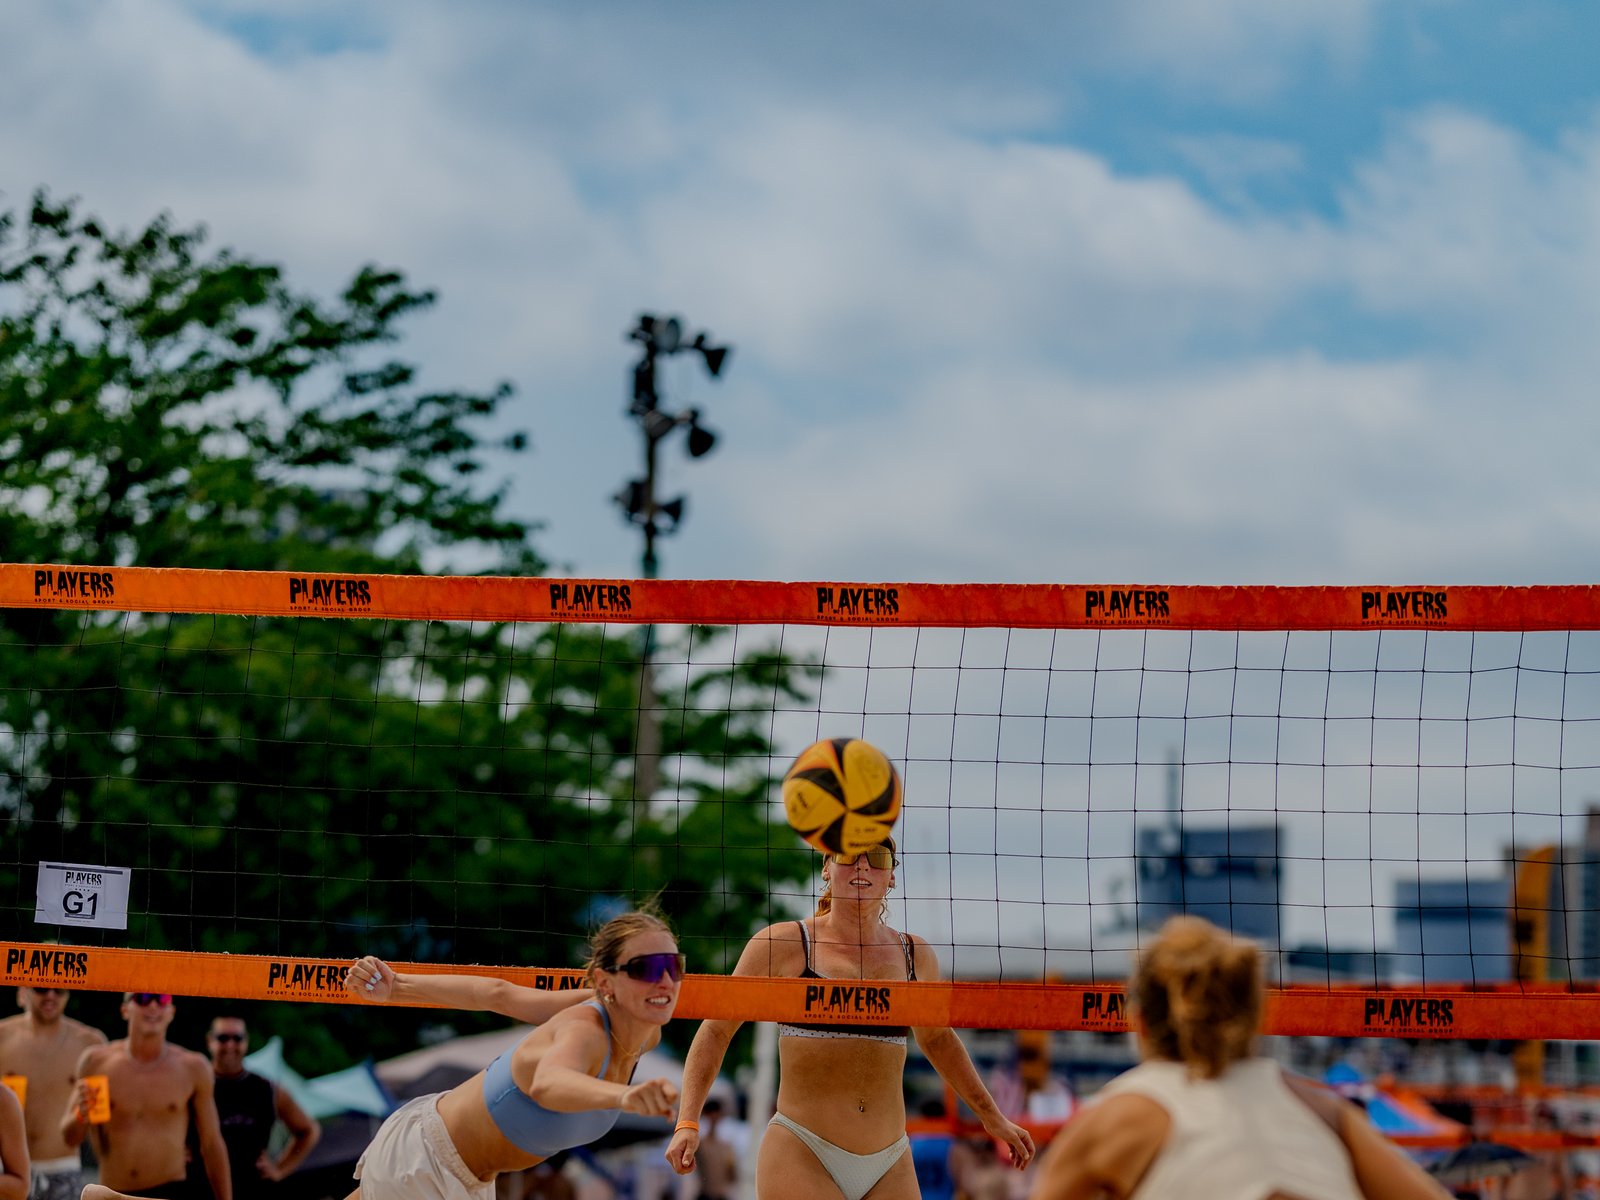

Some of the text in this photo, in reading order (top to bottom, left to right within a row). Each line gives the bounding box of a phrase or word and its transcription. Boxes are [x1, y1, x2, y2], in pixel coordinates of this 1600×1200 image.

[35, 570, 114, 598] PLAYERS
[290, 578, 371, 606] PLAYERS
[550, 584, 632, 612] PLAYERS
[816, 587, 899, 615] PLAYERS
[1085, 590, 1169, 618] PLAYERS
[1361, 591, 1447, 619] PLAYERS
[65, 871, 102, 886] PLAYERS
[62, 890, 98, 916] G1
[7, 949, 87, 977] PLAYERS
[268, 963, 349, 991] PLAYERS
[805, 986, 890, 1014] PLAYERS
[1082, 992, 1127, 1020] PLAY
[1364, 998, 1453, 1026] PLAYERS
